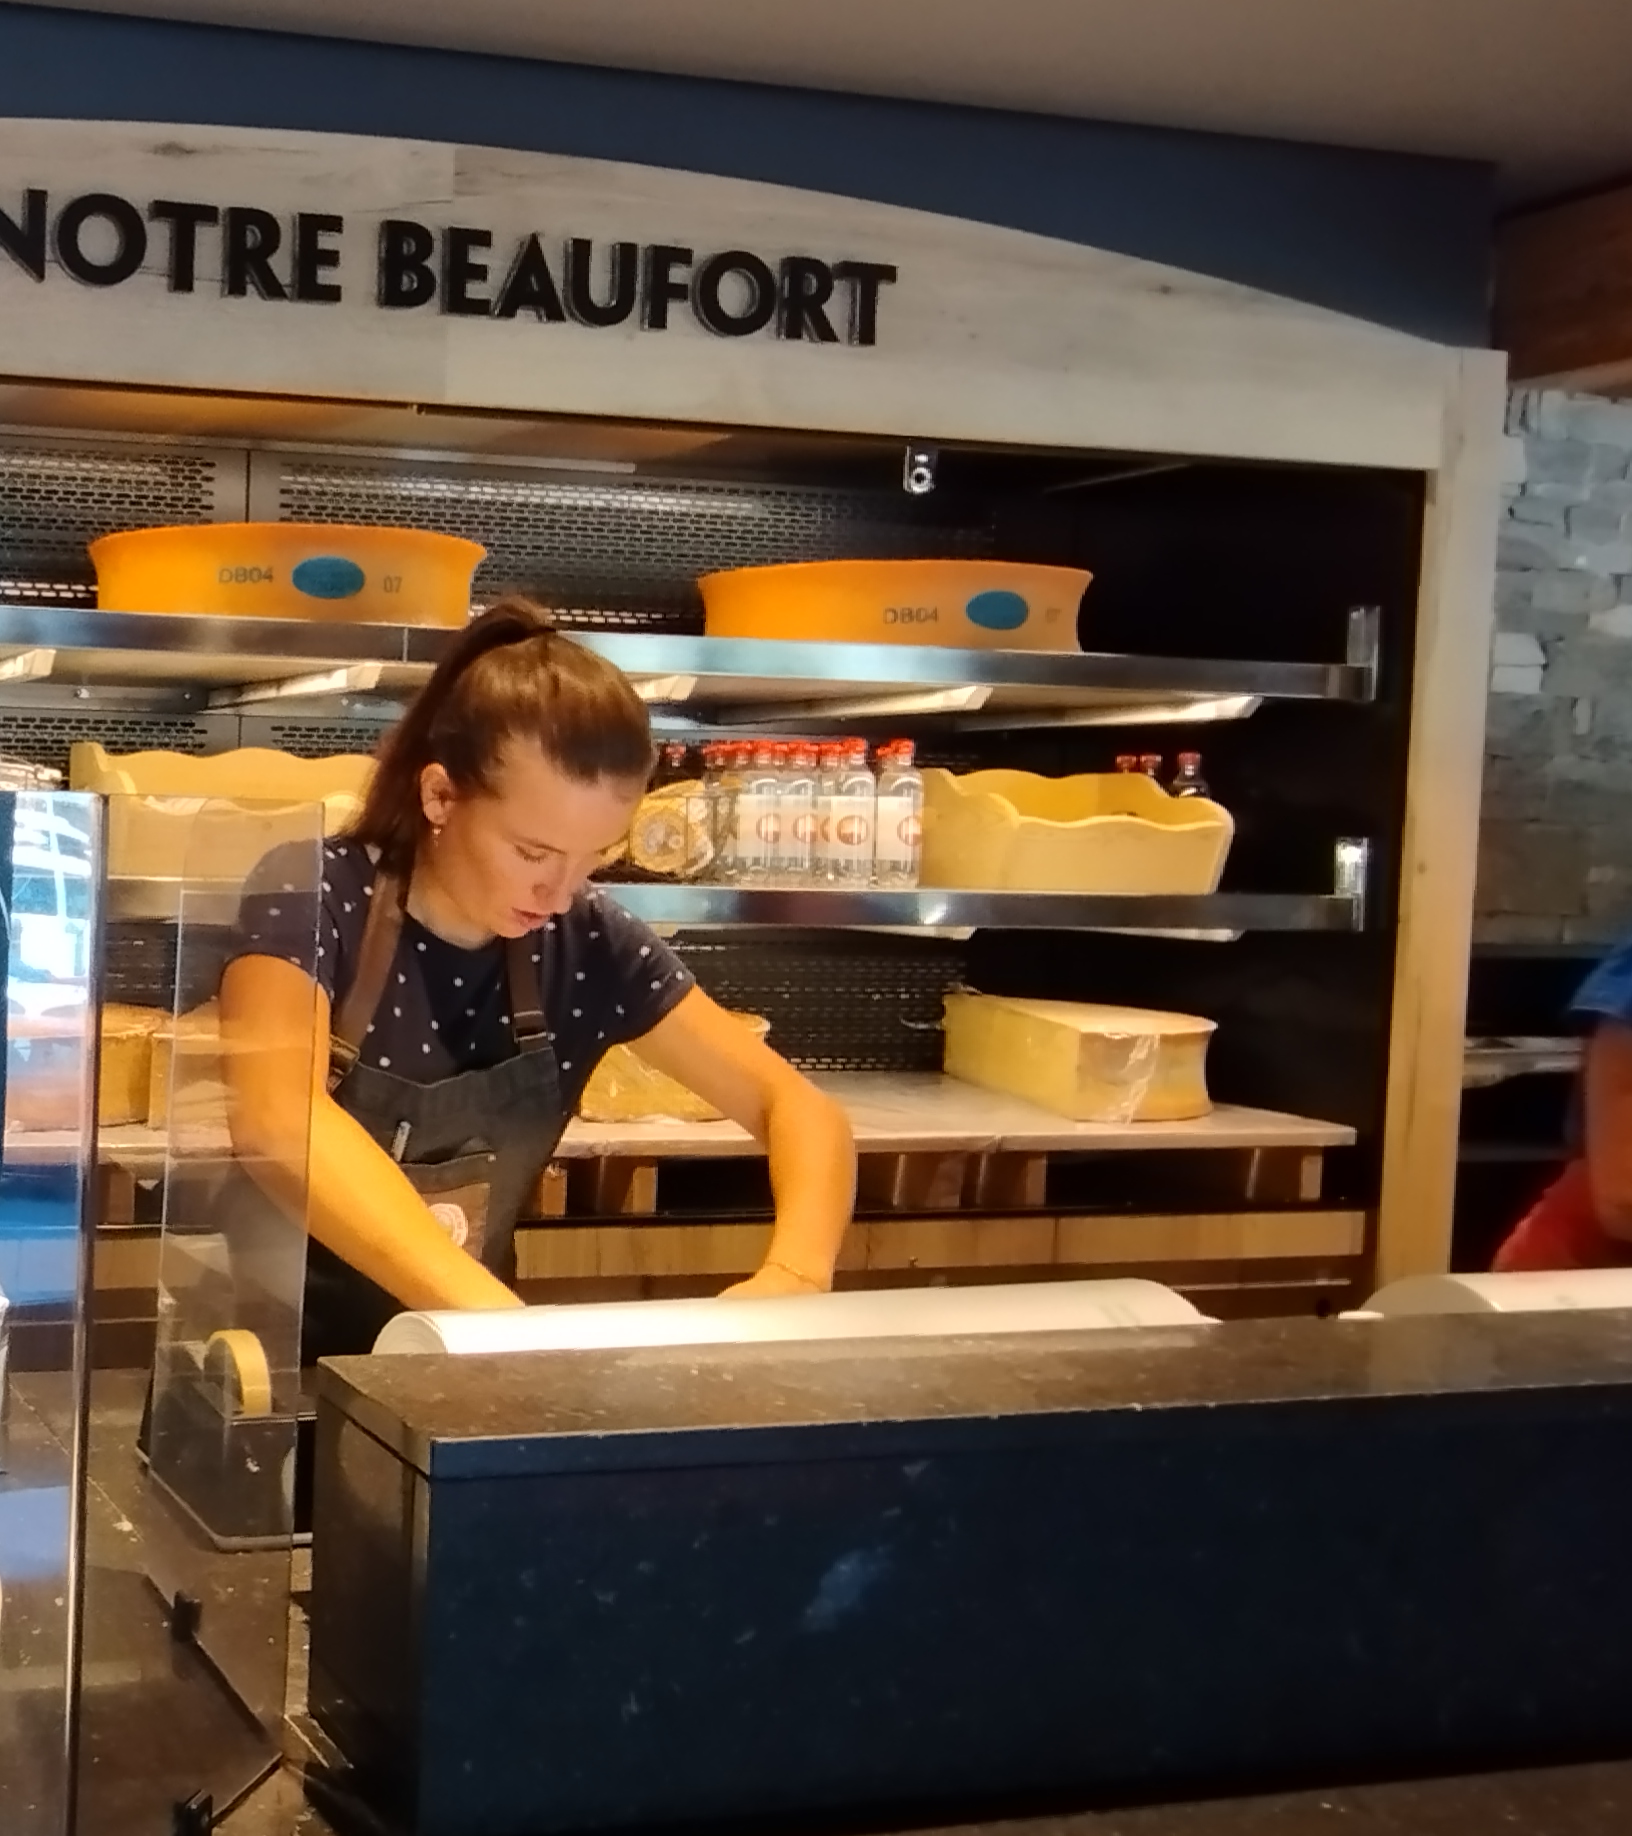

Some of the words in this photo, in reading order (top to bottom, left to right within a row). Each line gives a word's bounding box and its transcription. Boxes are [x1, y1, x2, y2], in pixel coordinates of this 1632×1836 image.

[377, 219, 898, 346] BEAUFORT
[218, 566, 274, 584] DB04
[382, 575, 403, 594] 07
